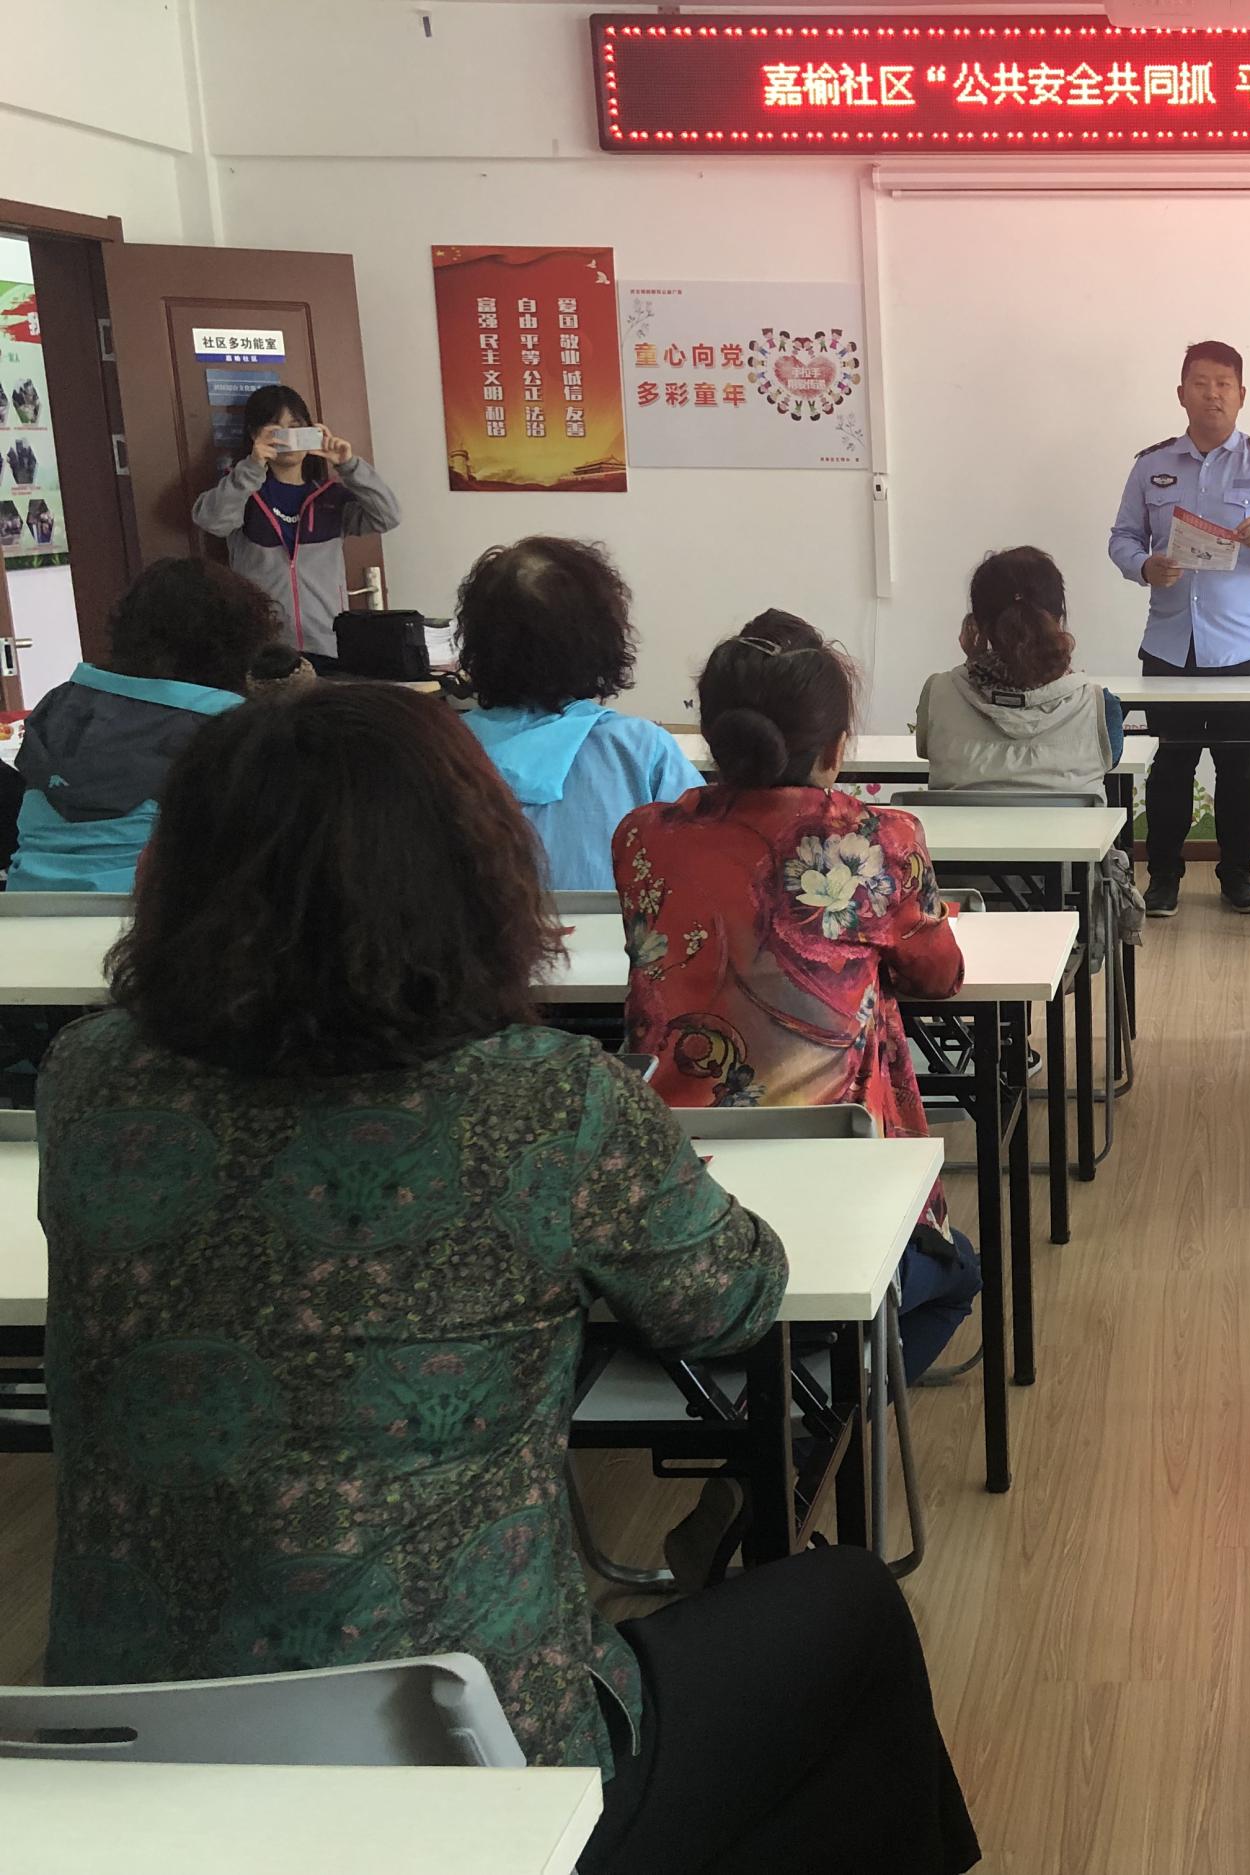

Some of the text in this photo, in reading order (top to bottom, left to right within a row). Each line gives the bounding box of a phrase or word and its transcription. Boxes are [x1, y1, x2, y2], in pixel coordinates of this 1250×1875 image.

[202, 336, 277, 350] 社区多功能室
[477, 296, 506, 437] 富强 民主 文明 和谐
[518, 297, 546, 437] 自由 平等 公正 法治
[557, 297, 586, 437] 爱国 敬业 诚信 友善
[634, 342, 744, 368] 童心向党
[637, 381, 746, 407] 多彩童年
